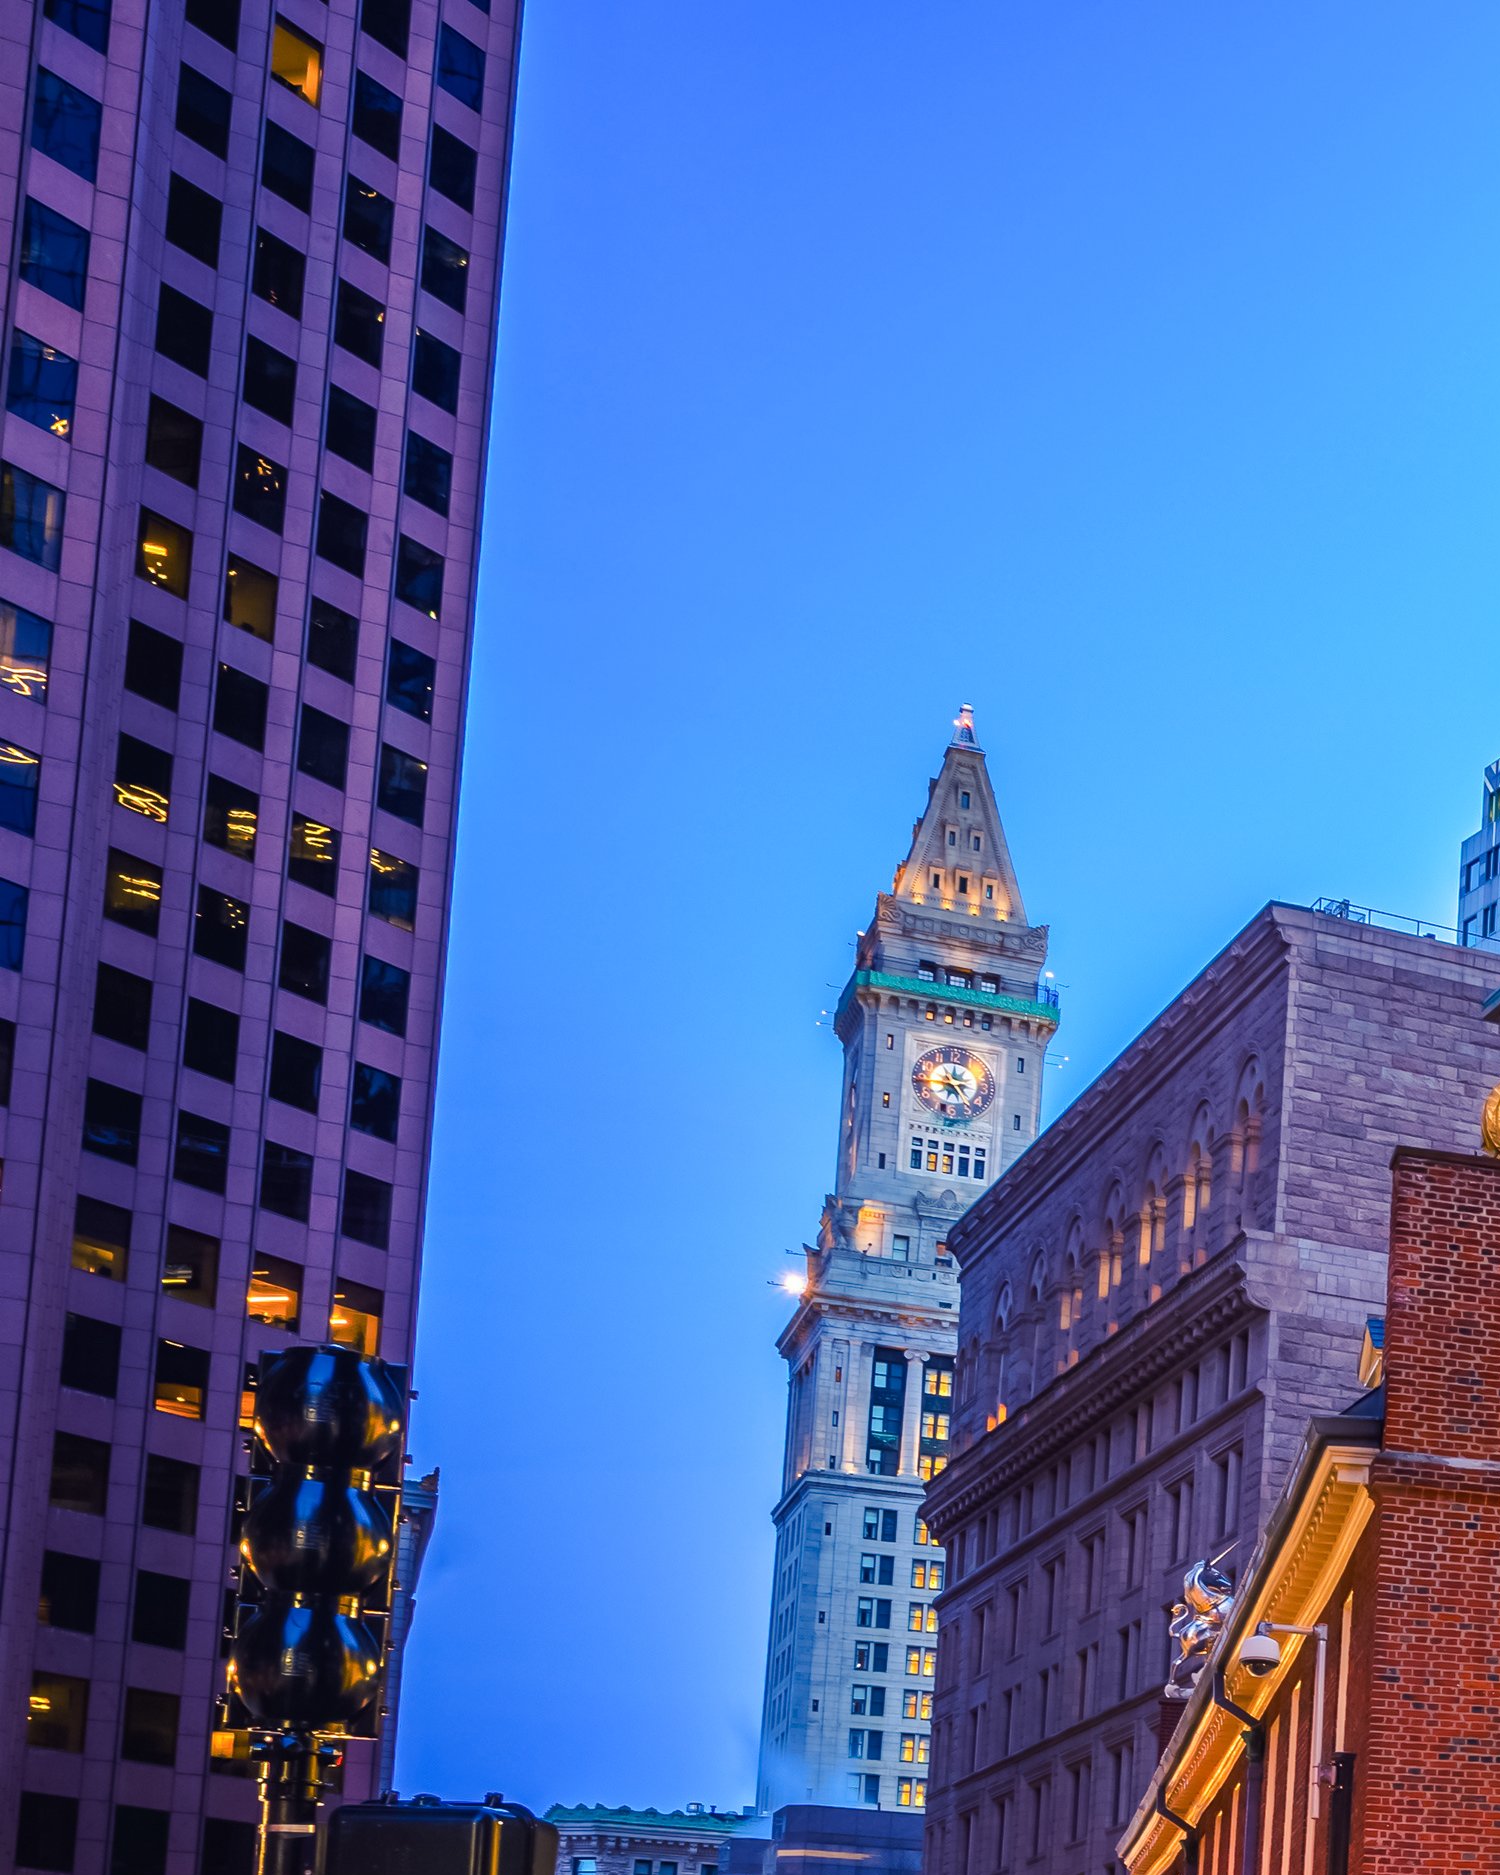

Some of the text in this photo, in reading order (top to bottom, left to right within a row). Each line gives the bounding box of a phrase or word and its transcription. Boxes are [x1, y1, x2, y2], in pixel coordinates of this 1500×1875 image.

[935, 1052, 943, 1063] 11
[950, 1051, 960, 1063] 12
[922, 1060, 933, 1073] 10
[921, 1086, 930, 1098] 8
[980, 1083, 988, 1095] 3
[973, 1096, 983, 1107] 4
[946, 1104, 956, 1116] 6
